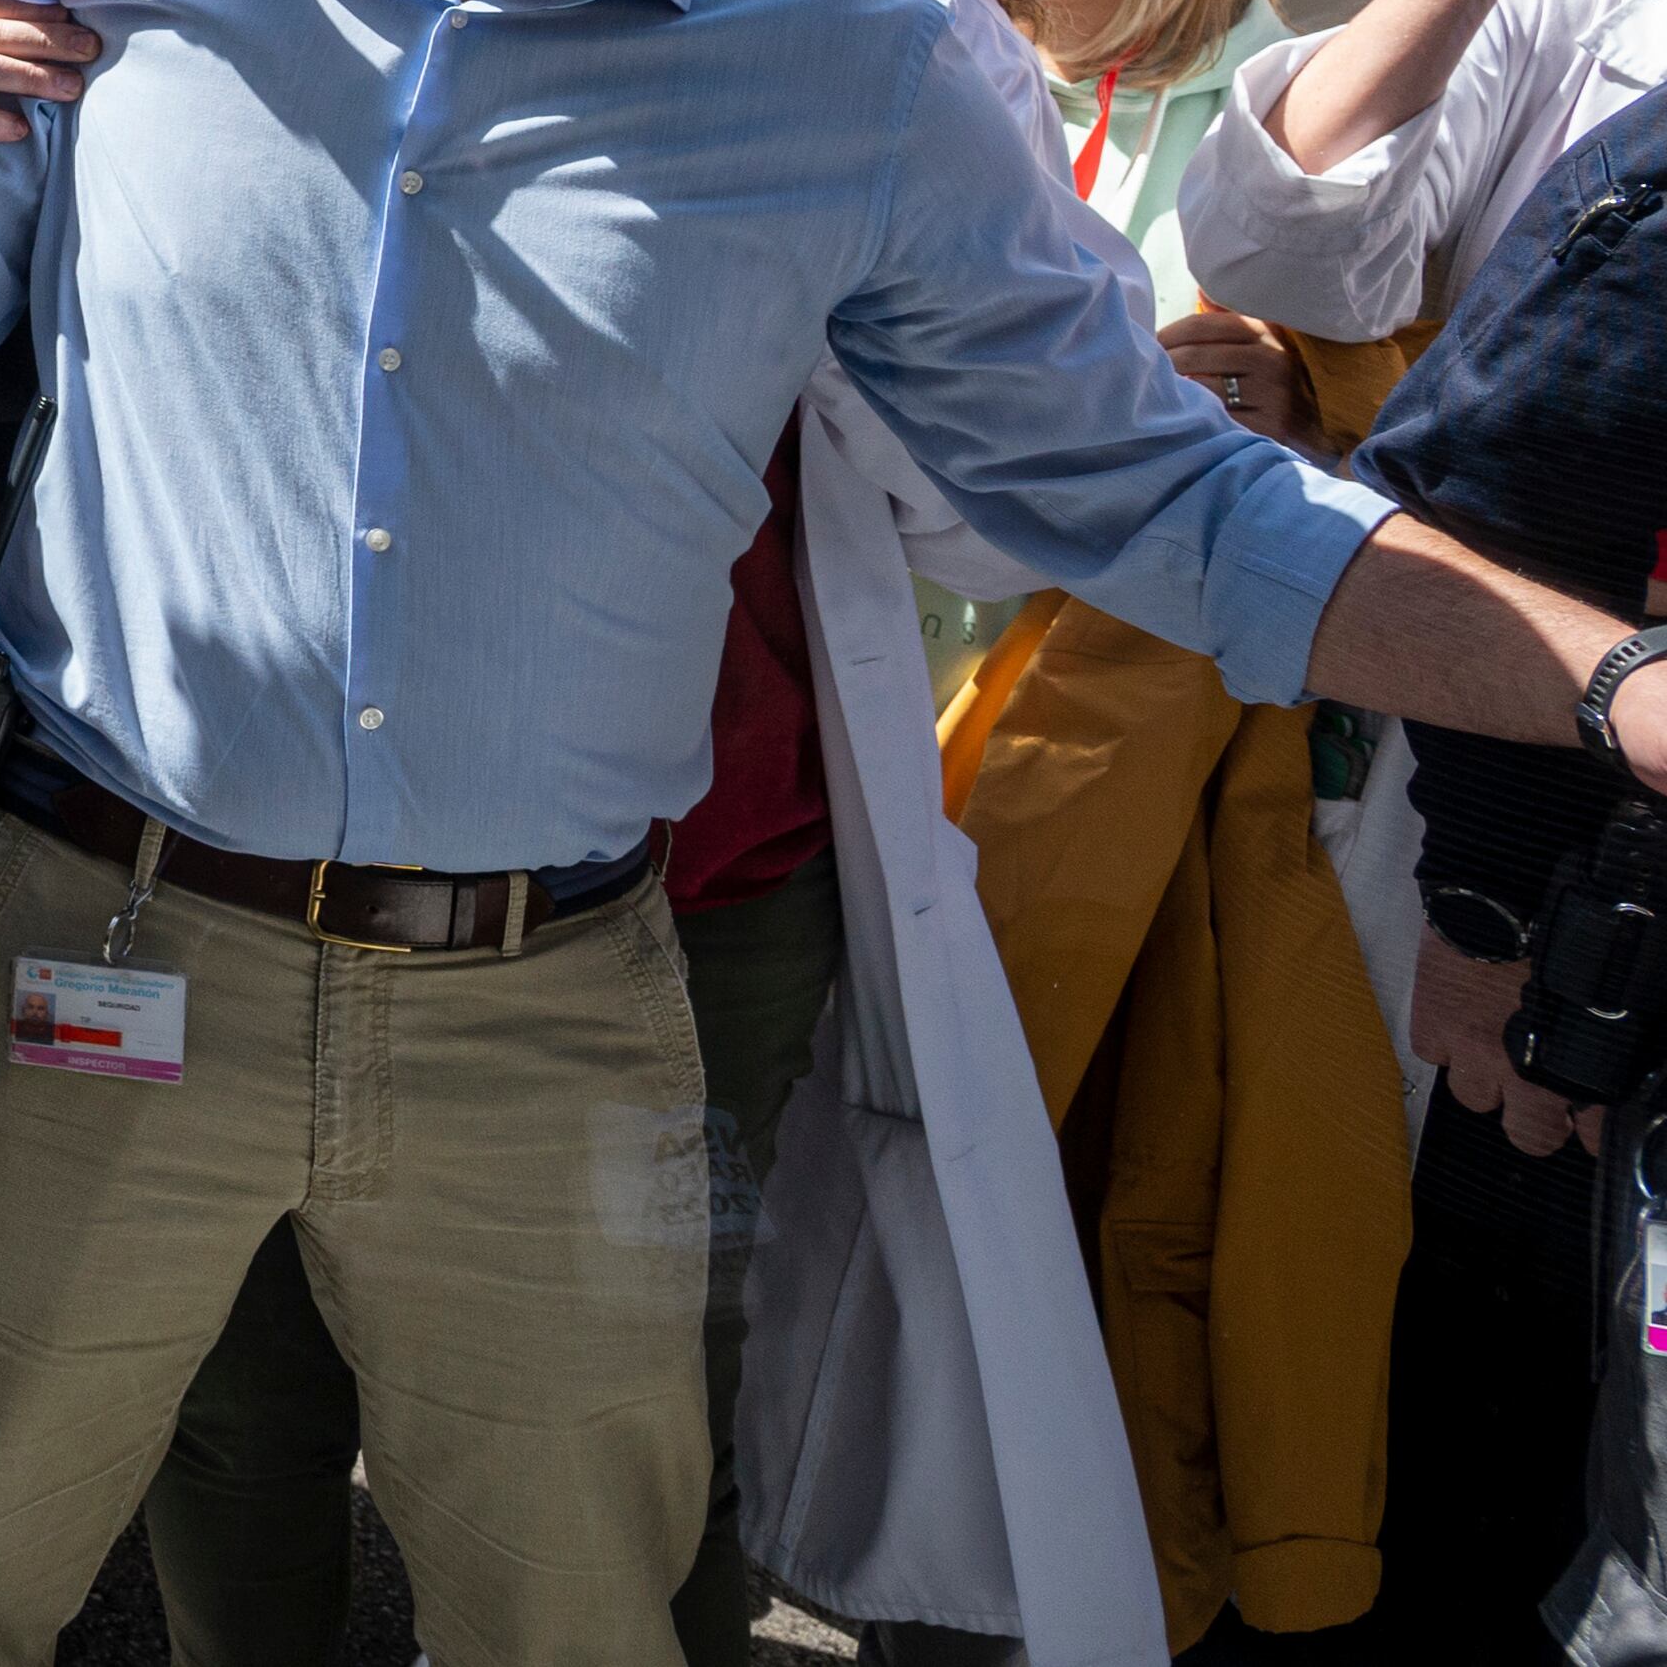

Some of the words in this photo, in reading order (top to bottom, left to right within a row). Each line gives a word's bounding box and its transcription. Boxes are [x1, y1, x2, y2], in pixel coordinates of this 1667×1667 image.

[54, 977, 105, 993] Gregorio
[108, 982, 161, 1000] Marañón
[67, 1056, 127, 1071] INSPECTOR
